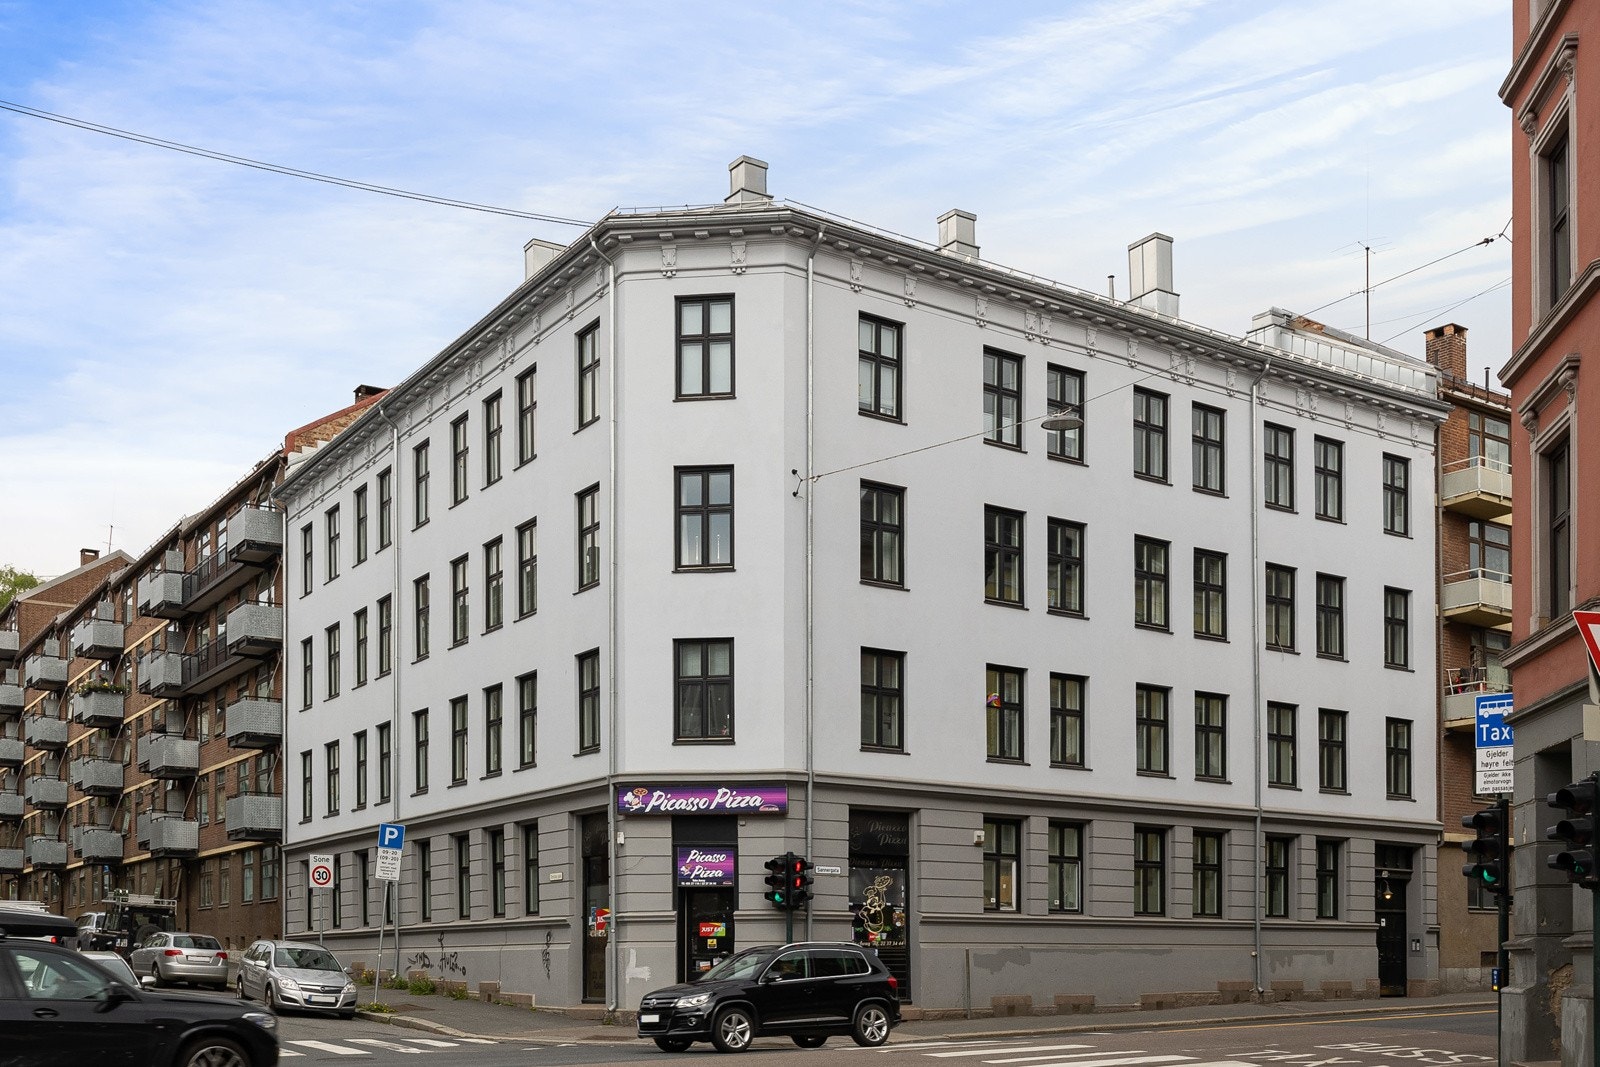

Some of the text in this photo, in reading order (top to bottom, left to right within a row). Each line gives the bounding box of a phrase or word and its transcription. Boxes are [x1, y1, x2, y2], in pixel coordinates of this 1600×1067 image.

[1486, 750, 1508, 759] Gjelder
[1481, 761, 1499, 769] høyre
[645, 787, 764, 812] Picasso Pizza
[384, 827, 398, 845] P
[686, 850, 726, 863] Picasso
[316, 870, 328, 881] 30
[690, 865, 724, 879] Pizza
[1314, 1042, 1494, 1064] BUSS
